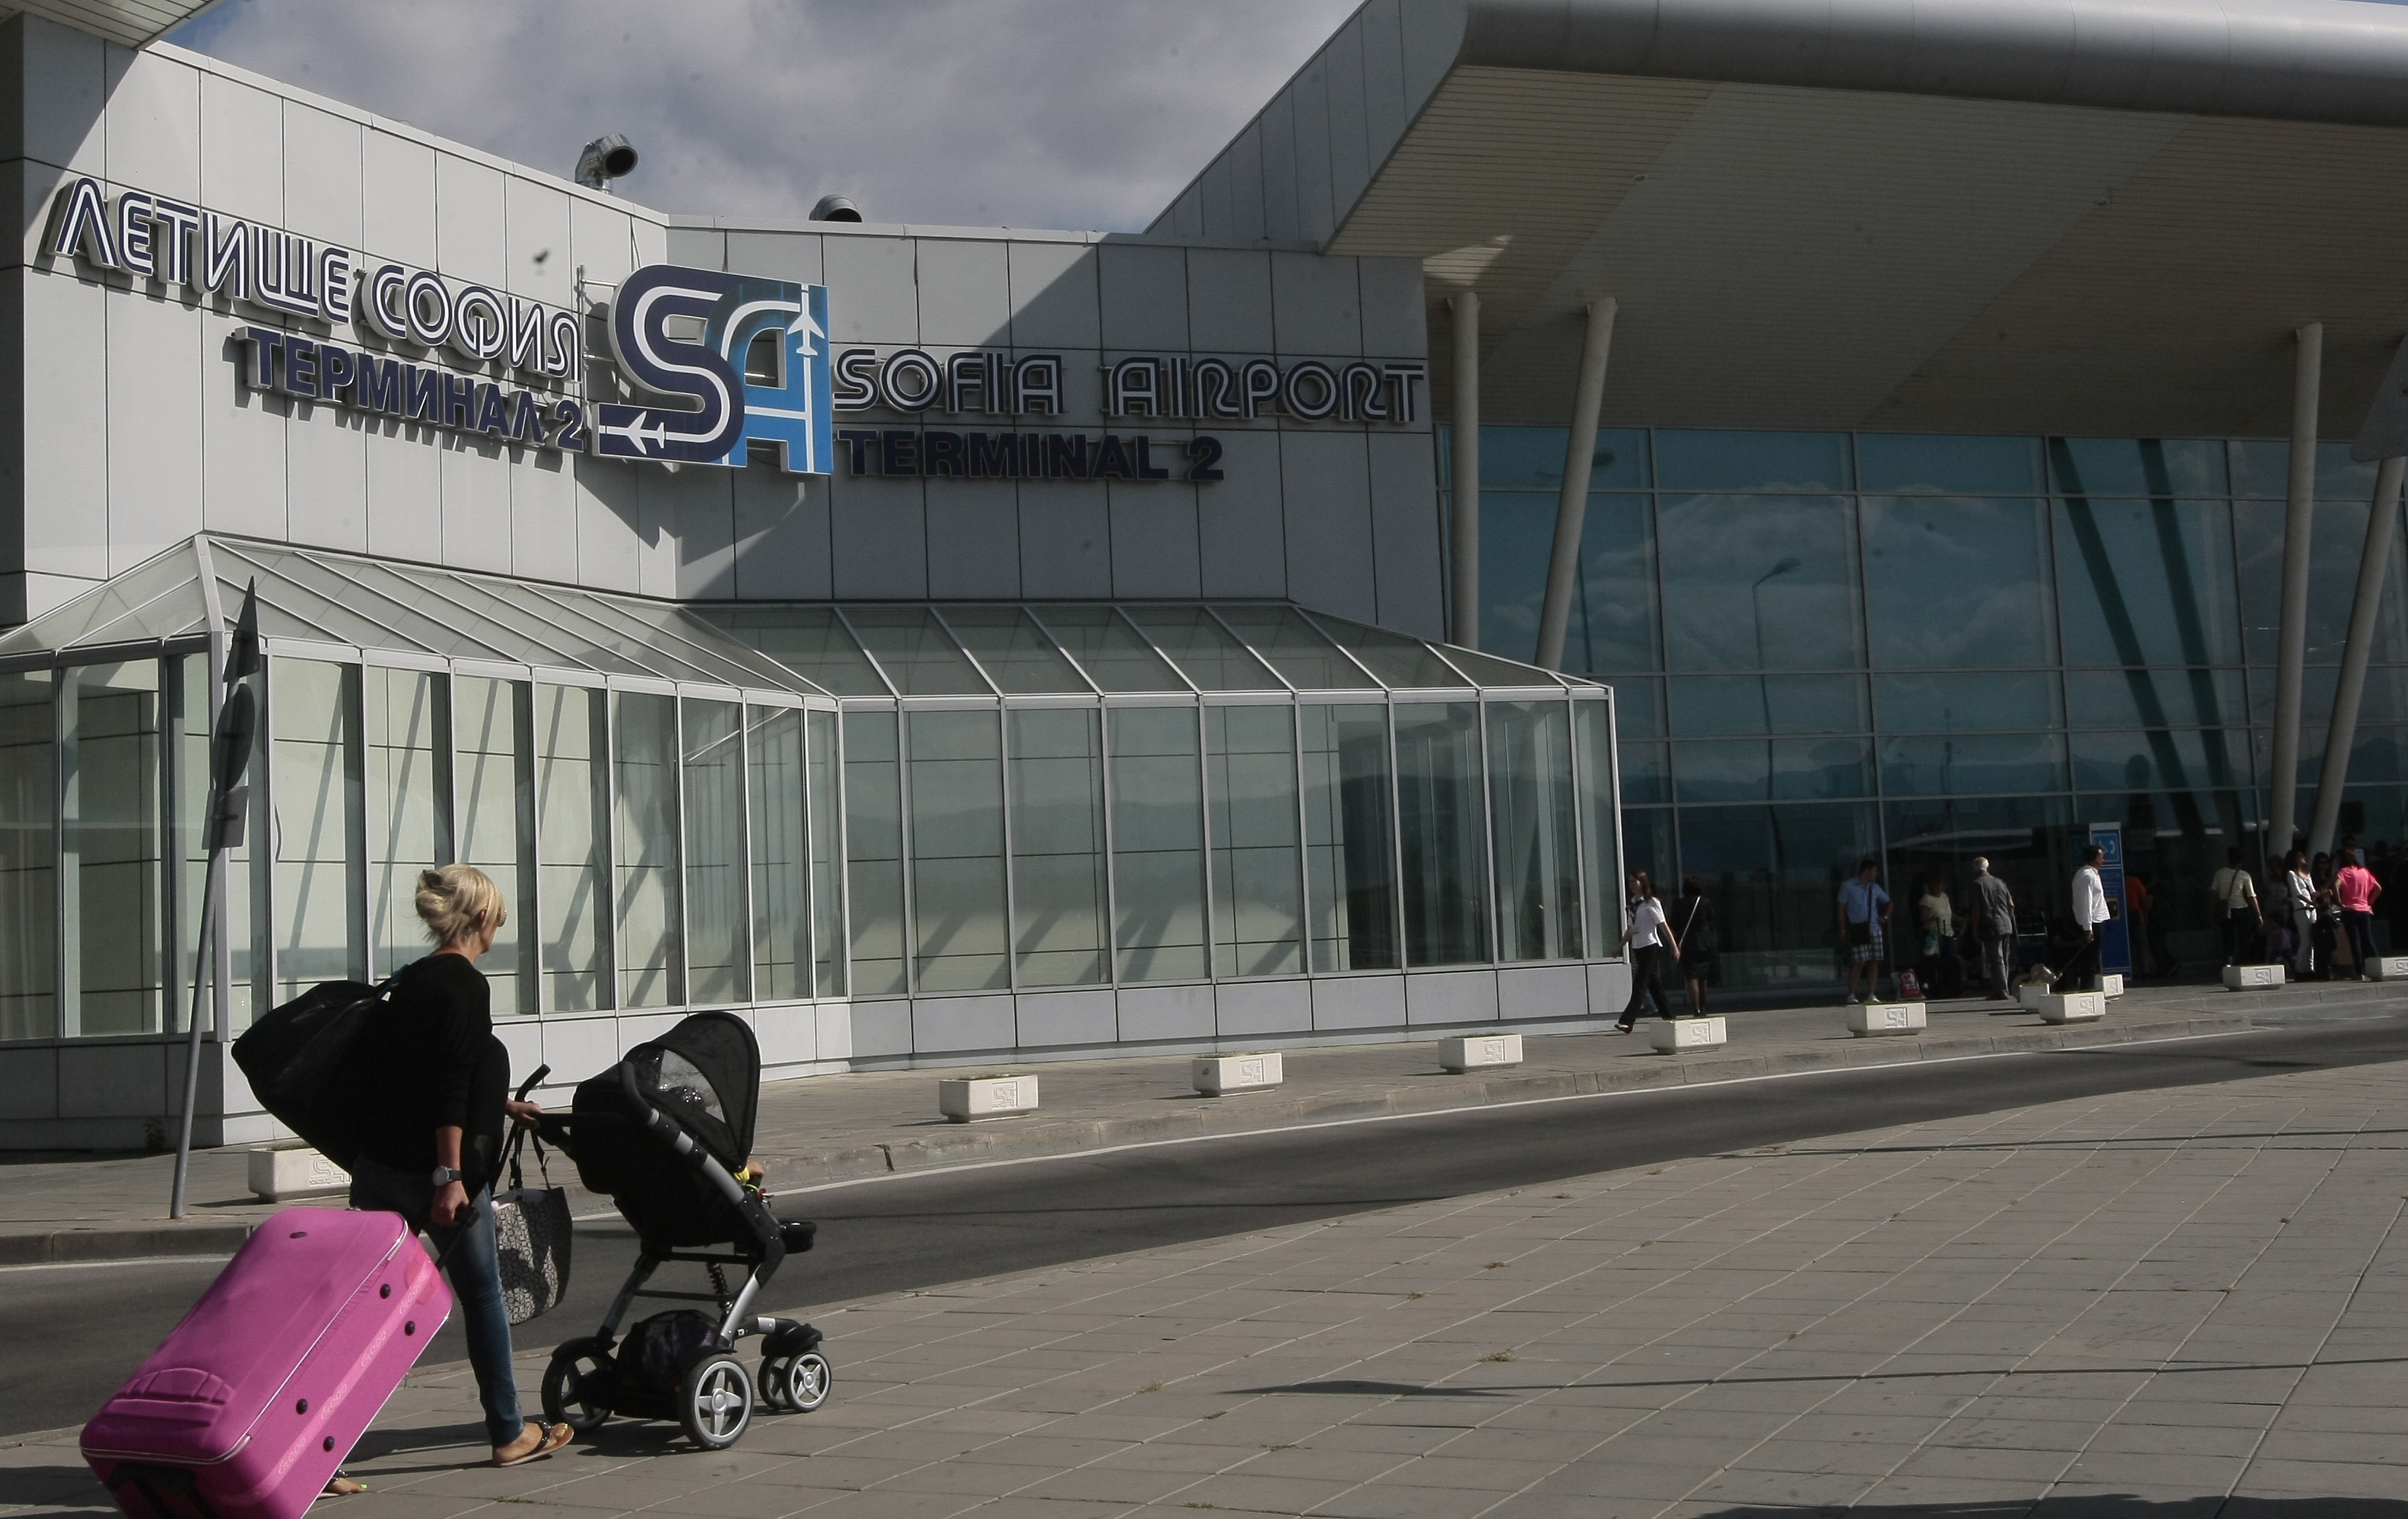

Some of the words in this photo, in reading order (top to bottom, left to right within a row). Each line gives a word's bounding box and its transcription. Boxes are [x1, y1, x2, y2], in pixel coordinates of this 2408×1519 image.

[54, 177, 350, 325] ЛЕТИЩЕ
[367, 263, 582, 384] СОФИЯ
[242, 325, 546, 447] ТЕРМИНАЛ
[552, 398, 584, 452] 2
[833, 347, 1063, 415] SOFIA
[1108, 355, 1425, 423] AIRPORT
[837, 429, 1169, 481] TERMINAL
[1186, 436, 1224, 482] 2
